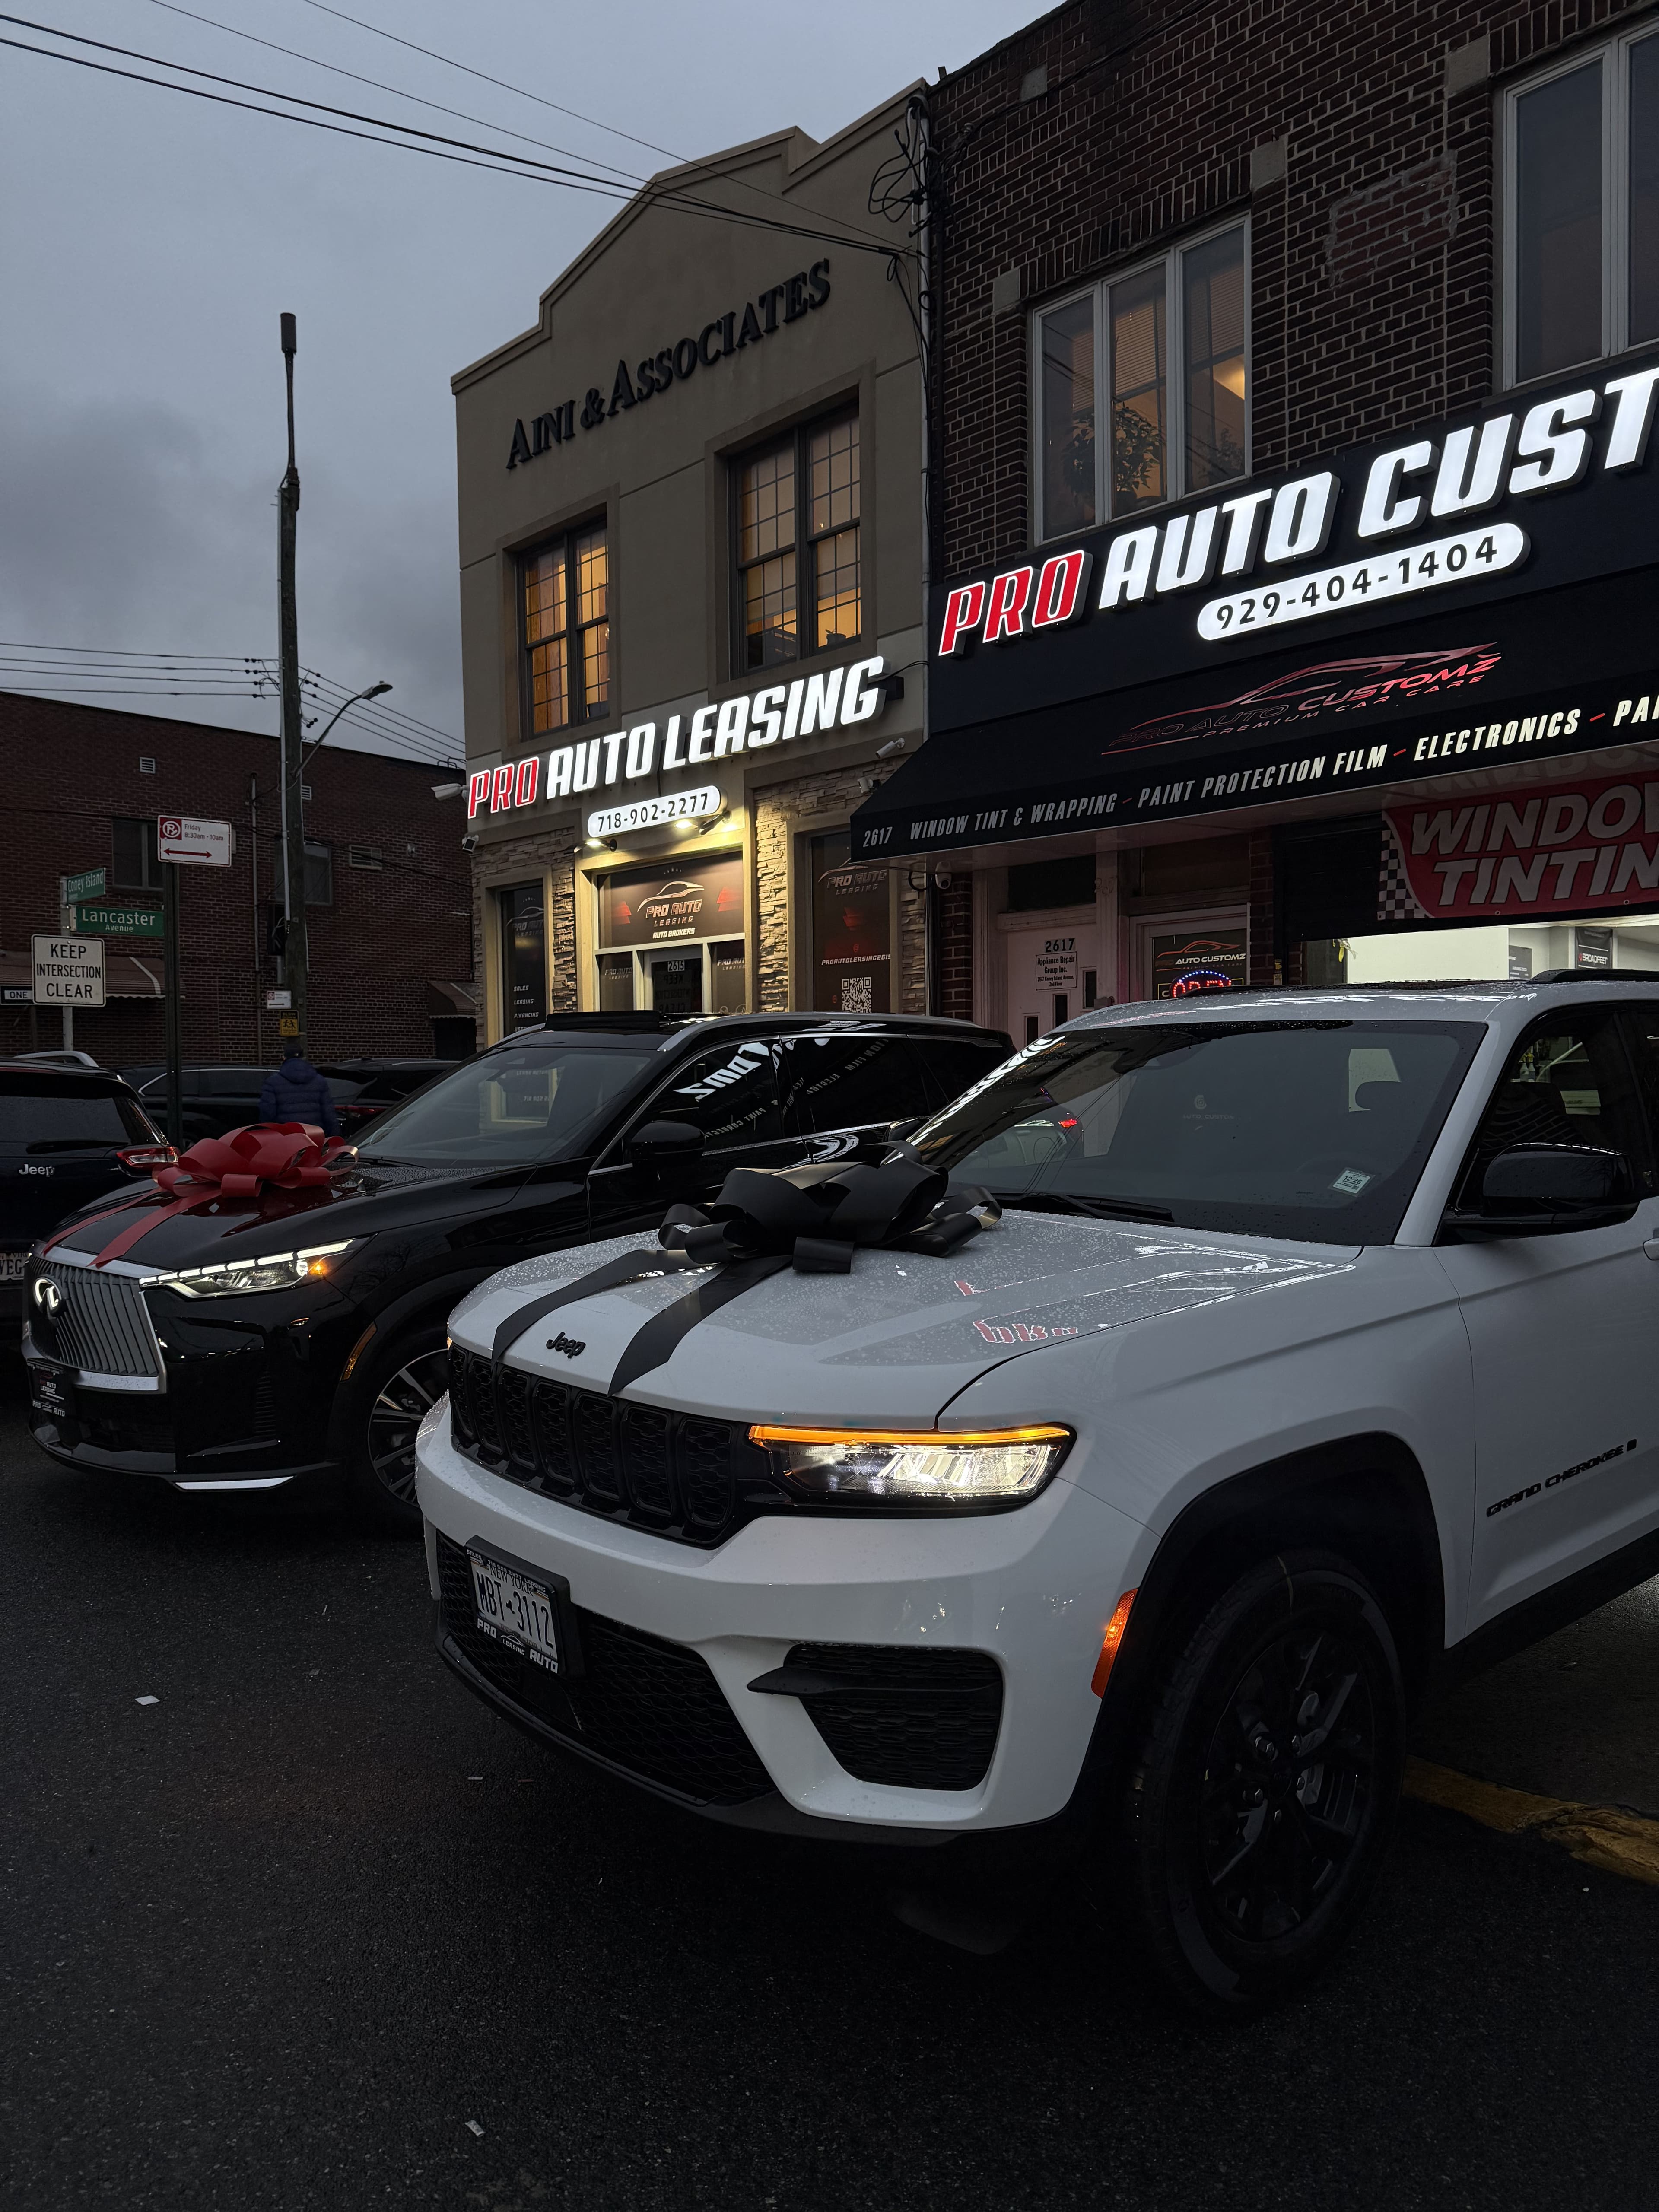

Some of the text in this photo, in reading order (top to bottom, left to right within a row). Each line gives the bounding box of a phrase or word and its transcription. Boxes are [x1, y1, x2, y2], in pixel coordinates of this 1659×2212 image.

[506, 258, 830, 470] AINI & ASSOCIATES
[938, 367, 1659, 656] PRO AUTO CUST
[1217, 536, 1498, 631] 929-404-1404
[1109, 652, 1502, 747] PRO AUTO CUSTOMZ
[1202, 675, 1485, 738] PREMIUM CAR CARE
[467, 655, 884, 819] PRO AUTO LEASING
[909, 815, 969, 840] WINDOW
[974, 809, 1008, 831] TINT
[1013, 807, 1023, 826] &
[1030, 793, 1118, 823] WRAPPING
[1138, 779, 1195, 808] PAINT
[1201, 756, 1325, 798] PROTECTION
[1332, 744, 1388, 775] FILM
[1414, 709, 1581, 761] ELECTRONICS
[597, 792, 708, 833] 718-902-2277
[863, 826, 893, 848] 2617
[68, 871, 103, 892] Coney Island
[827, 869, 888, 888] PRO AUTO
[836, 884, 878, 895] LEASING
[83, 909, 155, 925] Lancaster
[645, 899, 702, 919] PRO AUTO
[105, 924, 133, 932] Avenue
[654, 916, 693, 927] LEASING
[652, 928, 696, 939] AUTO BROKERS
[51, 944, 86, 959] KEEP
[1046, 938, 1075, 953] 2617
[668, 961, 684, 971] 2615
[1038, 955, 1074, 966] Appliance Repair
[1201, 953, 1246, 963] CUSTOMZ
[1582, 953, 1608, 964] BROADFEET
[37, 964, 101, 978] INTERSECTION
[47, 983, 92, 998] CLEAR
[18, 1163, 55, 1177] Jeep
[546, 1332, 586, 1359] Jeep
[32, 1400, 41, 1409] PRO
[53, 1408, 65, 1417] AUTO
[1486, 1445, 1624, 1517] GRAND CHEROKEE
[467, 1549, 483, 1560] SALES
[489, 1565, 508, 1583] NEW
[477, 1618, 497, 1639] PRO
[503, 1638, 525, 1656] LEASING
[529, 1649, 558, 1674] AUTO
